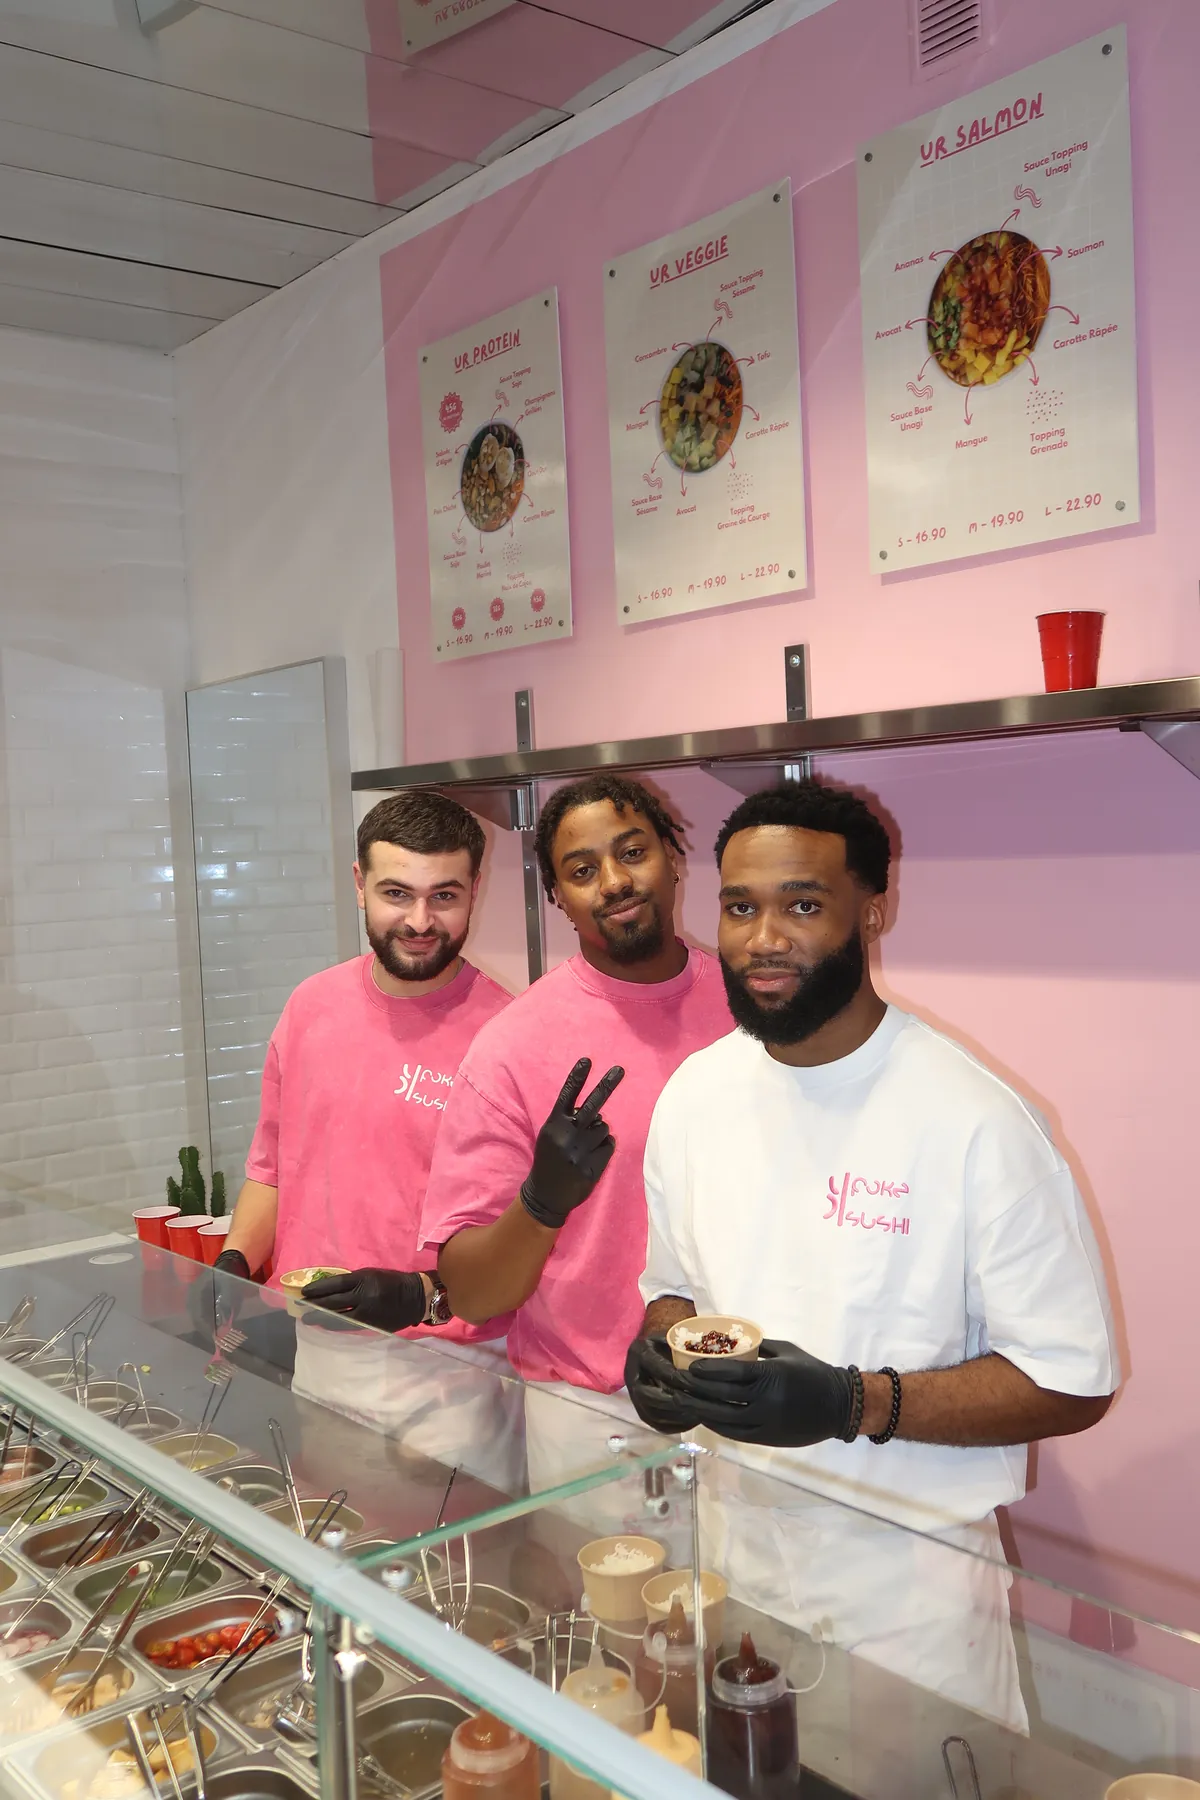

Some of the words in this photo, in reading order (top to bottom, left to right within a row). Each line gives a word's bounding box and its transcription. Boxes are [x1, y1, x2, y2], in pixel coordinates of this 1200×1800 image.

[920, 136, 947, 161] UR
[956, 92, 1044, 148] SALMON
[1023, 155, 1050, 172] Sauce
[1051, 140, 1088, 164] Topping
[1045, 160, 1072, 177] Unagi
[1067, 239, 1105, 258] Saumon
[650, 264, 670, 284] UR
[676, 235, 729, 274] VEGGIE
[894, 256, 924, 272] Ananas
[720, 280, 738, 292] Sauce
[738, 269, 763, 285] Topping
[875, 325, 902, 340] Avocat
[1053, 333, 1087, 350] Carotte
[1088, 323, 1118, 342] Râpée
[455, 353, 470, 370] UR
[473, 329, 521, 364] PROTEIN
[890, 410, 913, 422] Sauce
[914, 404, 933, 416] Base
[900, 418, 924, 432] Unagi
[955, 434, 988, 449] Mangue
[1030, 426, 1066, 443] Topping
[1030, 440, 1069, 455] Grenade
[676, 505, 697, 516] Avocat
[730, 504, 755, 516] Topping
[1045, 506, 1052, 516] L
[1066, 493, 1102, 513] 22.90
[739, 516, 746, 526] de
[969, 522, 978, 533] M
[991, 510, 1024, 529] 19.90
[898, 537, 903, 548] S
[915, 527, 946, 545] 16.90
[755, 563, 780, 579] 22.90
[703, 575, 727, 589] 19.90
[845, 1211, 910, 1235] SUSHI
